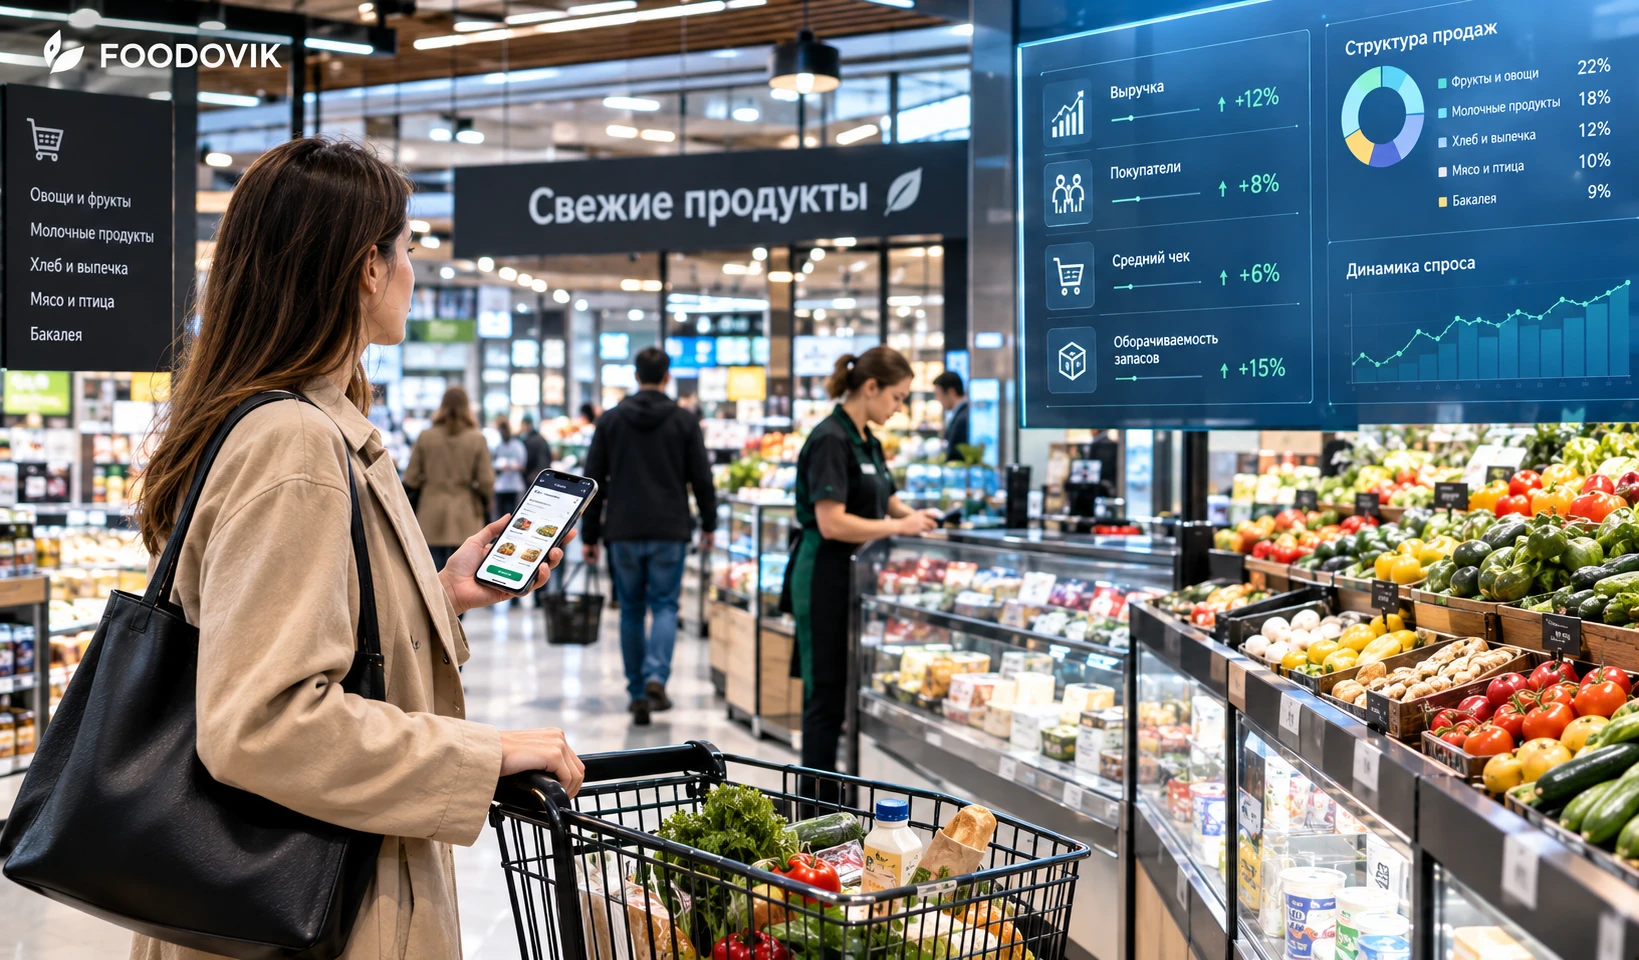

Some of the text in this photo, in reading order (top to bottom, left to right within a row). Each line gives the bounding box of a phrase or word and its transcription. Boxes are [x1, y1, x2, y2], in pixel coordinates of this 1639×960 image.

[1346, 23, 1497, 57] Структура продаж
[1578, 57, 1610, 75] 22%
[1452, 70, 1538, 89] Фрукты и овощи
[1111, 83, 1164, 99] Выручка
[1236, 87, 1279, 107] +12%
[1579, 89, 1610, 105] 18%
[1453, 98, 1560, 117] Молочные продукты
[1579, 121, 1610, 137] 12%
[1453, 132, 1536, 146] Хлеб и выпечка
[1579, 152, 1611, 168] 10%
[1111, 163, 1180, 180] Покупатели
[1453, 165, 1479, 176] Мясо
[1493, 163, 1524, 173] птица
[1239, 173, 1279, 193] +8%
[1588, 184, 1610, 198] 9%
[31, 187, 131, 209] Овощи и фрукты
[529, 183, 867, 227] Свежие продукты
[1453, 195, 1496, 206] Бакалея
[31, 222, 153, 244] Молочные продукты
[31, 257, 128, 275] Хлеб и выпечка
[1113, 251, 1190, 269] Средний чек
[1347, 259, 1475, 279] Динамика спроса
[1240, 263, 1279, 283] +6%
[31, 292, 114, 310] Мясо и птица
[31, 327, 82, 341] Бакалея
[1114, 335, 1218, 350] Оборачиваемость
[1115, 354, 1159, 365] запасов
[1239, 358, 1285, 377] +15%
